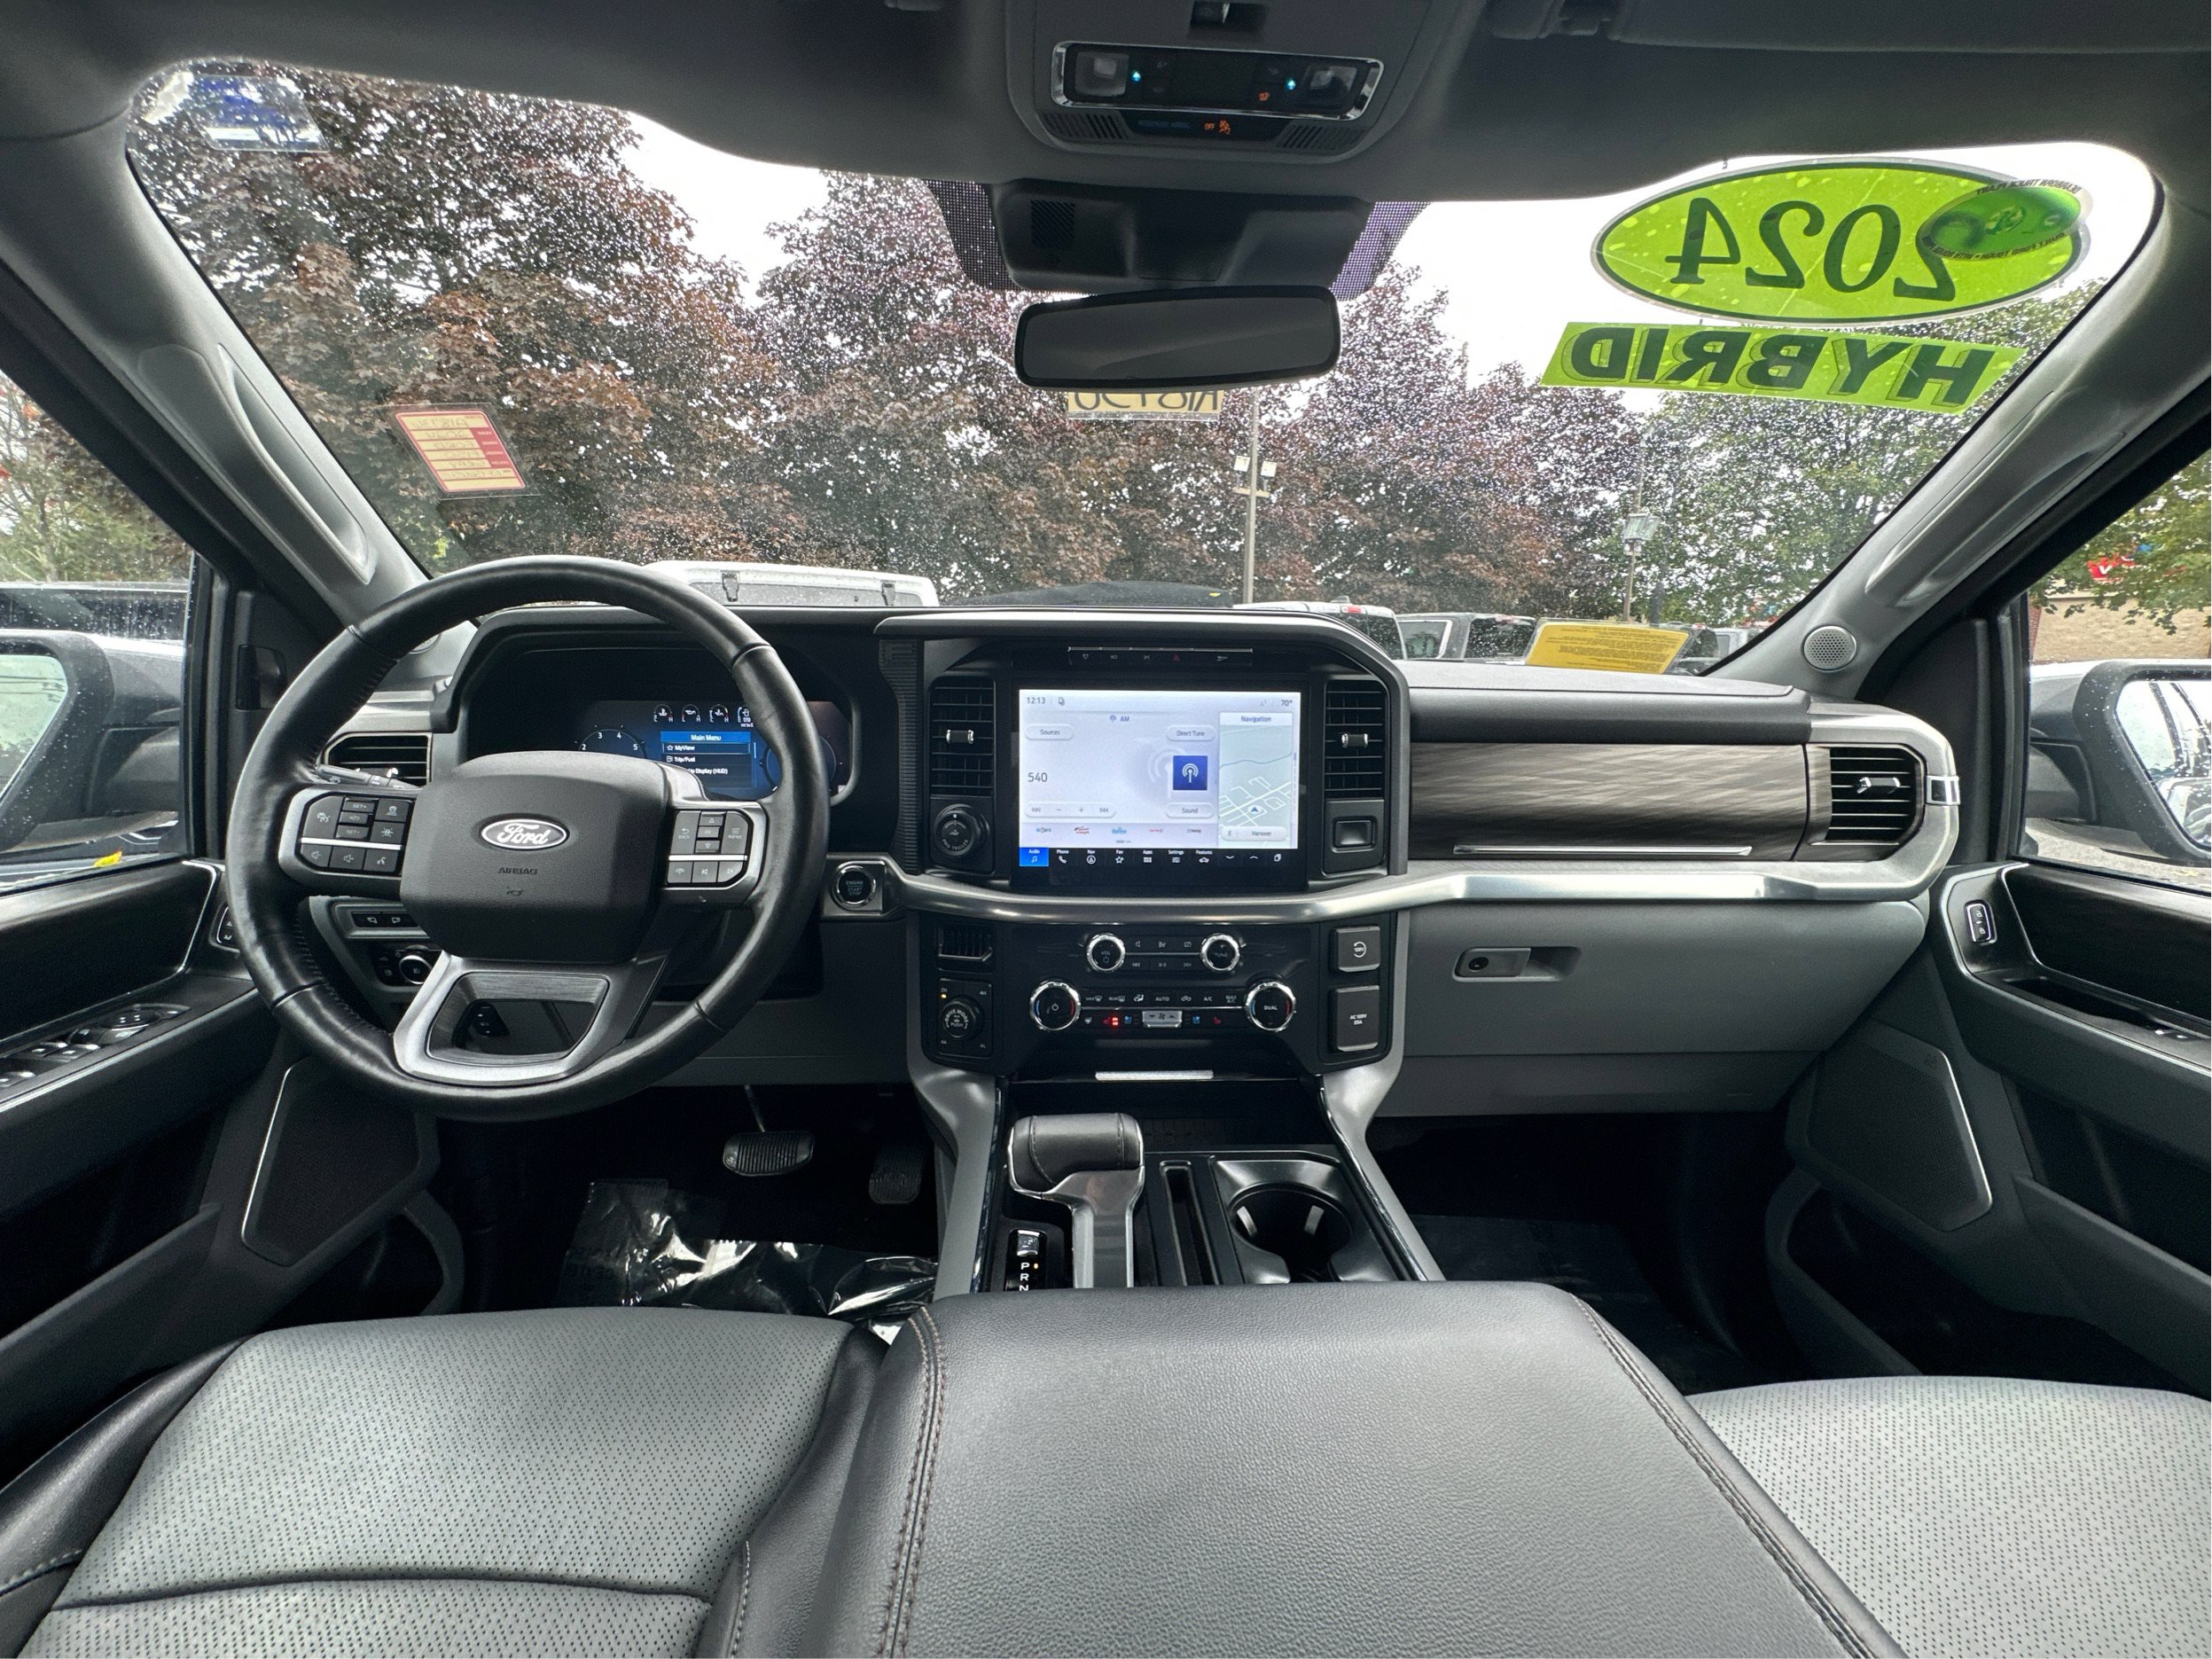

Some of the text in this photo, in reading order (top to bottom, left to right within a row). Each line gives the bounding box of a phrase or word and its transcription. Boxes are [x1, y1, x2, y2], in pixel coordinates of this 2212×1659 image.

[1204, 122, 1215, 131] OFF
[1028, 772, 1049, 783] 540
[496, 823, 551, 844] Ford
[951, 839, 969, 851] TRAILER
[944, 1009, 969, 1022] DRIVE MODE
[1020, 1272, 1029, 1281] R
